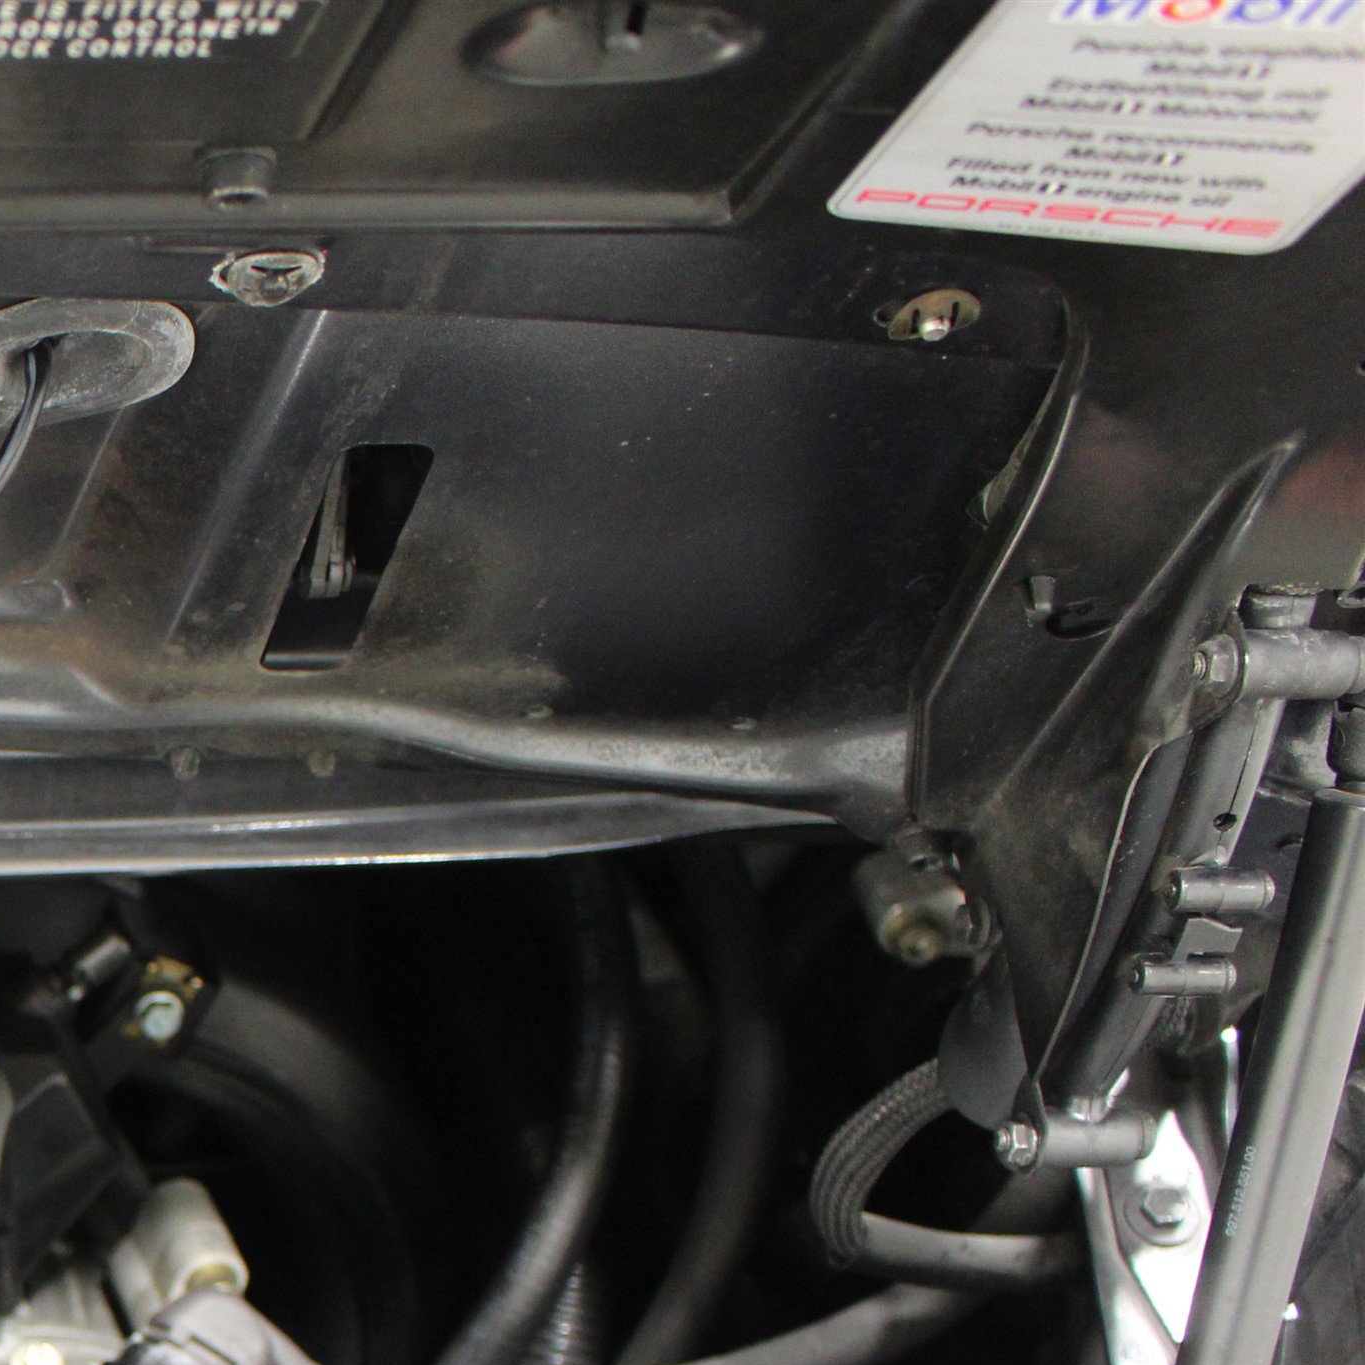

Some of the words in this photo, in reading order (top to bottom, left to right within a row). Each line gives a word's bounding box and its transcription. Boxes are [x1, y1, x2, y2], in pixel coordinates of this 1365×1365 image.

[33, 0, 69, 20] IS
[82, 0, 202, 20] FITTED
[215, 0, 298, 20] WITH
[66, 36, 213, 59] CONTROL
[1146, 61, 1233, 76] Mobil
[1020, 96, 1109, 112] Mobil
[966, 121, 1094, 141] Porsche
[1104, 132, 1315, 153] recommends
[1065, 146, 1151, 164] Mobil
[946, 155, 1033, 175] Filled
[1040, 163, 1112, 179] from
[1119, 172, 1187, 186] new
[1198, 174, 1267, 190] with
[949, 174, 1035, 193] Mobil
[1074, 186, 1182, 204] engine
[1189, 193, 1233, 207] oil
[856, 188, 1284, 238] PORSCHE
